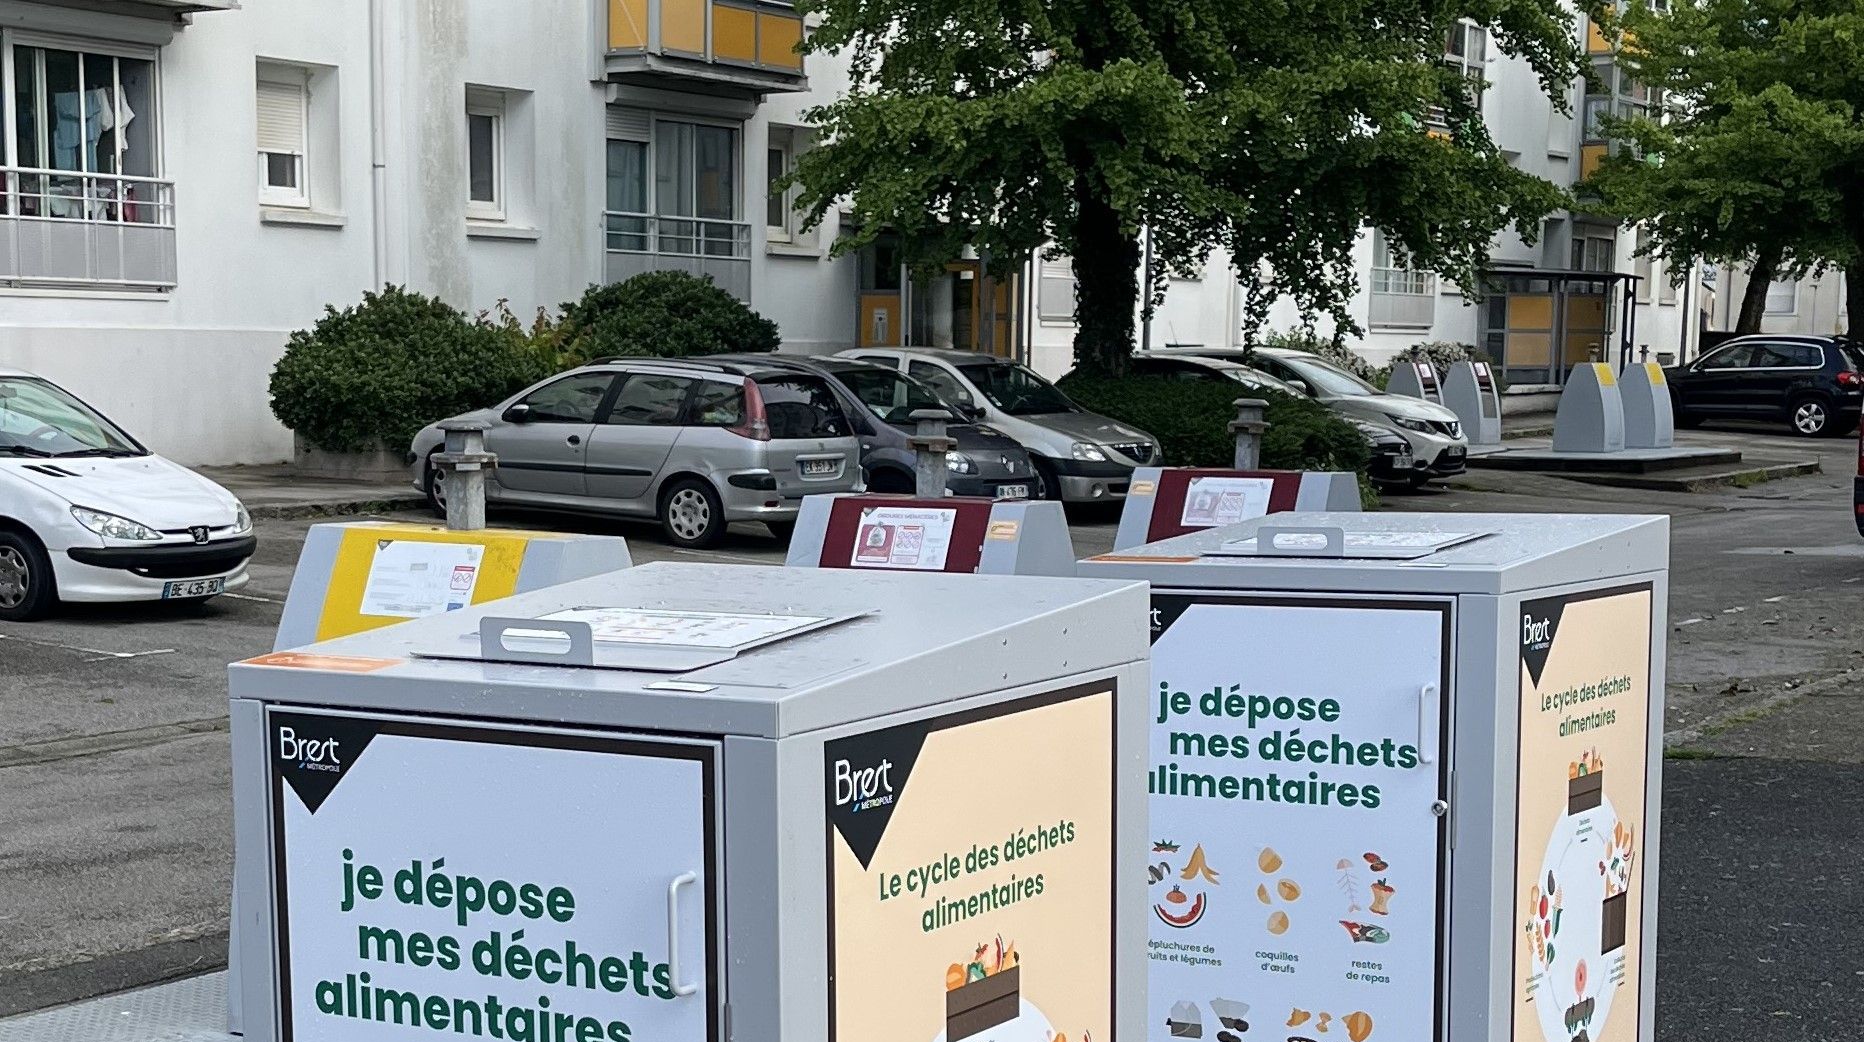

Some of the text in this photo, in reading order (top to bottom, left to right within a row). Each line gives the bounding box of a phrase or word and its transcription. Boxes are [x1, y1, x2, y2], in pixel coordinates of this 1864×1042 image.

[1523, 614, 1550, 645] Brest
[1157, 681, 1340, 729] je dépose
[1541, 675, 1631, 714] Le cycle des déchets
[1559, 707, 1616, 737] alimentaires
[280, 726, 340, 764] Brest
[1170, 728, 1418, 768] mes déchets
[835, 758, 893, 806] Brest
[879, 819, 1075, 902] Le cycle des déchets
[341, 848, 575, 926] je dépose
[922, 873, 1044, 933] alimentaires
[359, 925, 677, 999] mes déchets
[1148, 939, 1215, 954] épluchures de
[1181, 954, 1222, 966] légumes
[1255, 950, 1299, 963] coquilles
[1351, 959, 1384, 971] restes
[1346, 971, 1390, 984] de repas
